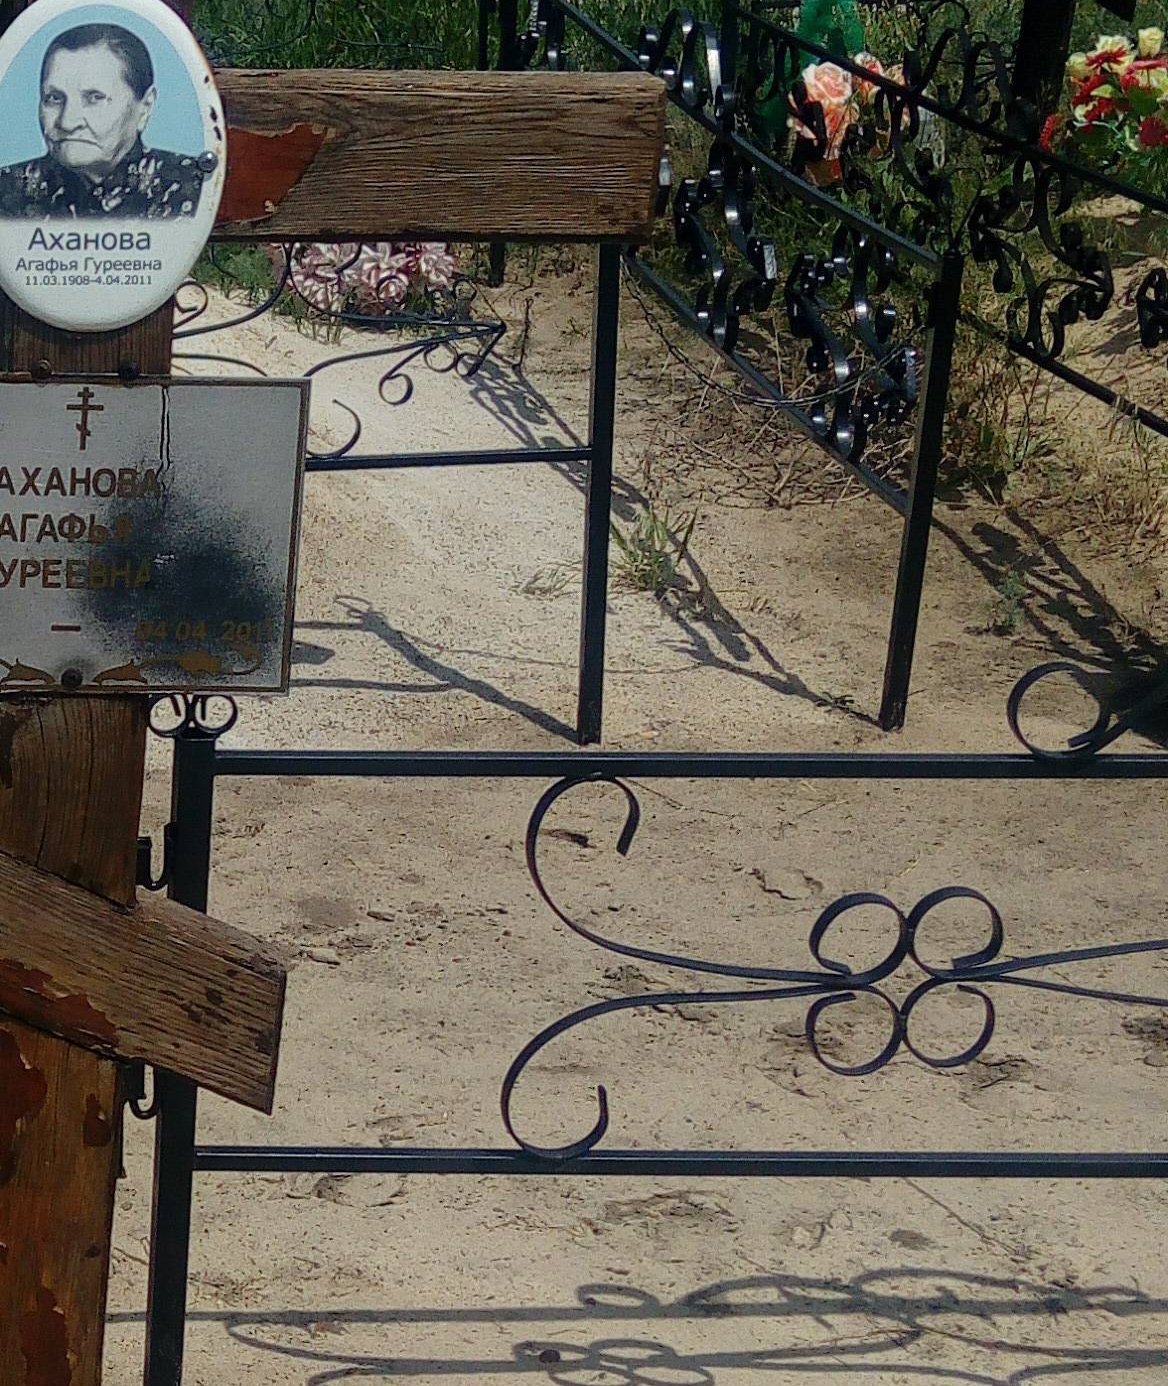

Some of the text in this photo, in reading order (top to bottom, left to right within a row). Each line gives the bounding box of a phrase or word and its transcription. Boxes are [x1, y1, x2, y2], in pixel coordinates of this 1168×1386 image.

[28, 227, 151, 250] Аханова
[15, 257, 162, 274] Агафья Гуреевна
